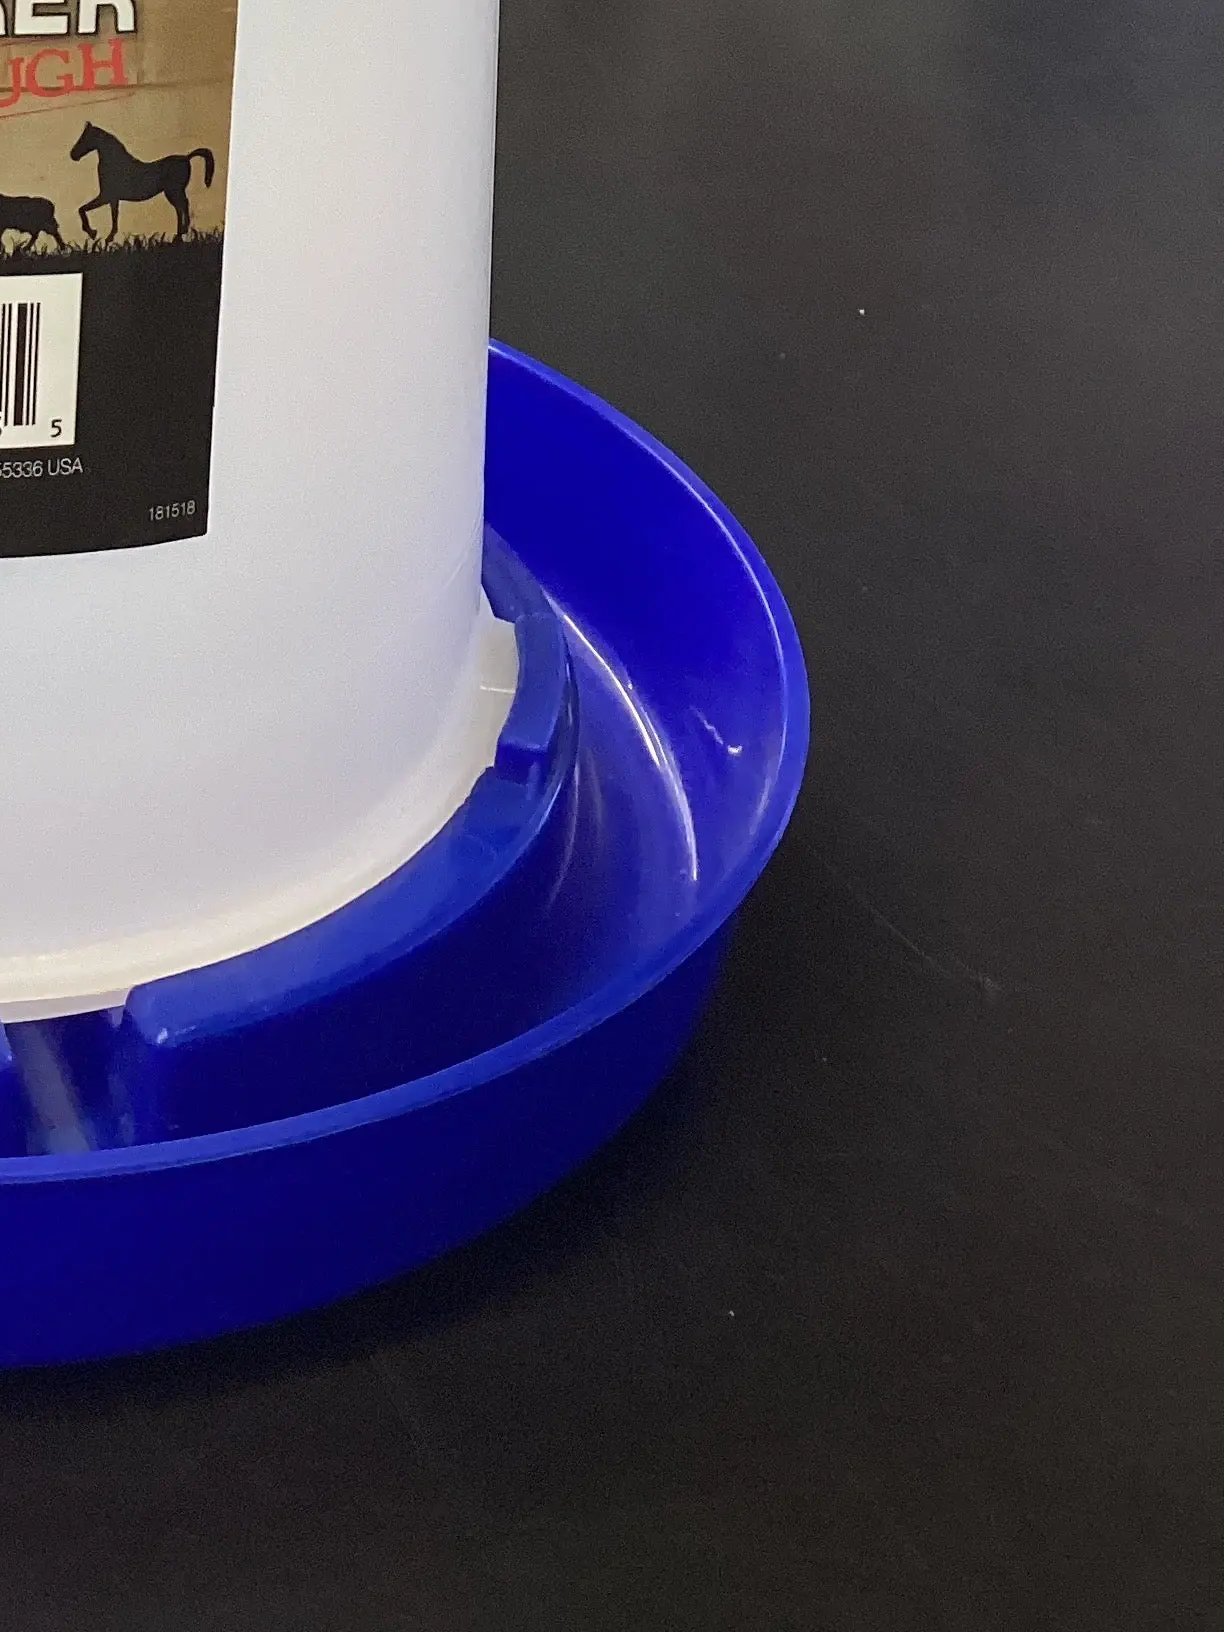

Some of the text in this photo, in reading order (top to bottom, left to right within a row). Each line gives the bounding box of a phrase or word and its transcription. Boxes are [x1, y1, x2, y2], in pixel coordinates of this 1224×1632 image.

[50, 419, 63, 438] 5
[47, 457, 84, 476] USA
[149, 500, 196, 521] 181518
